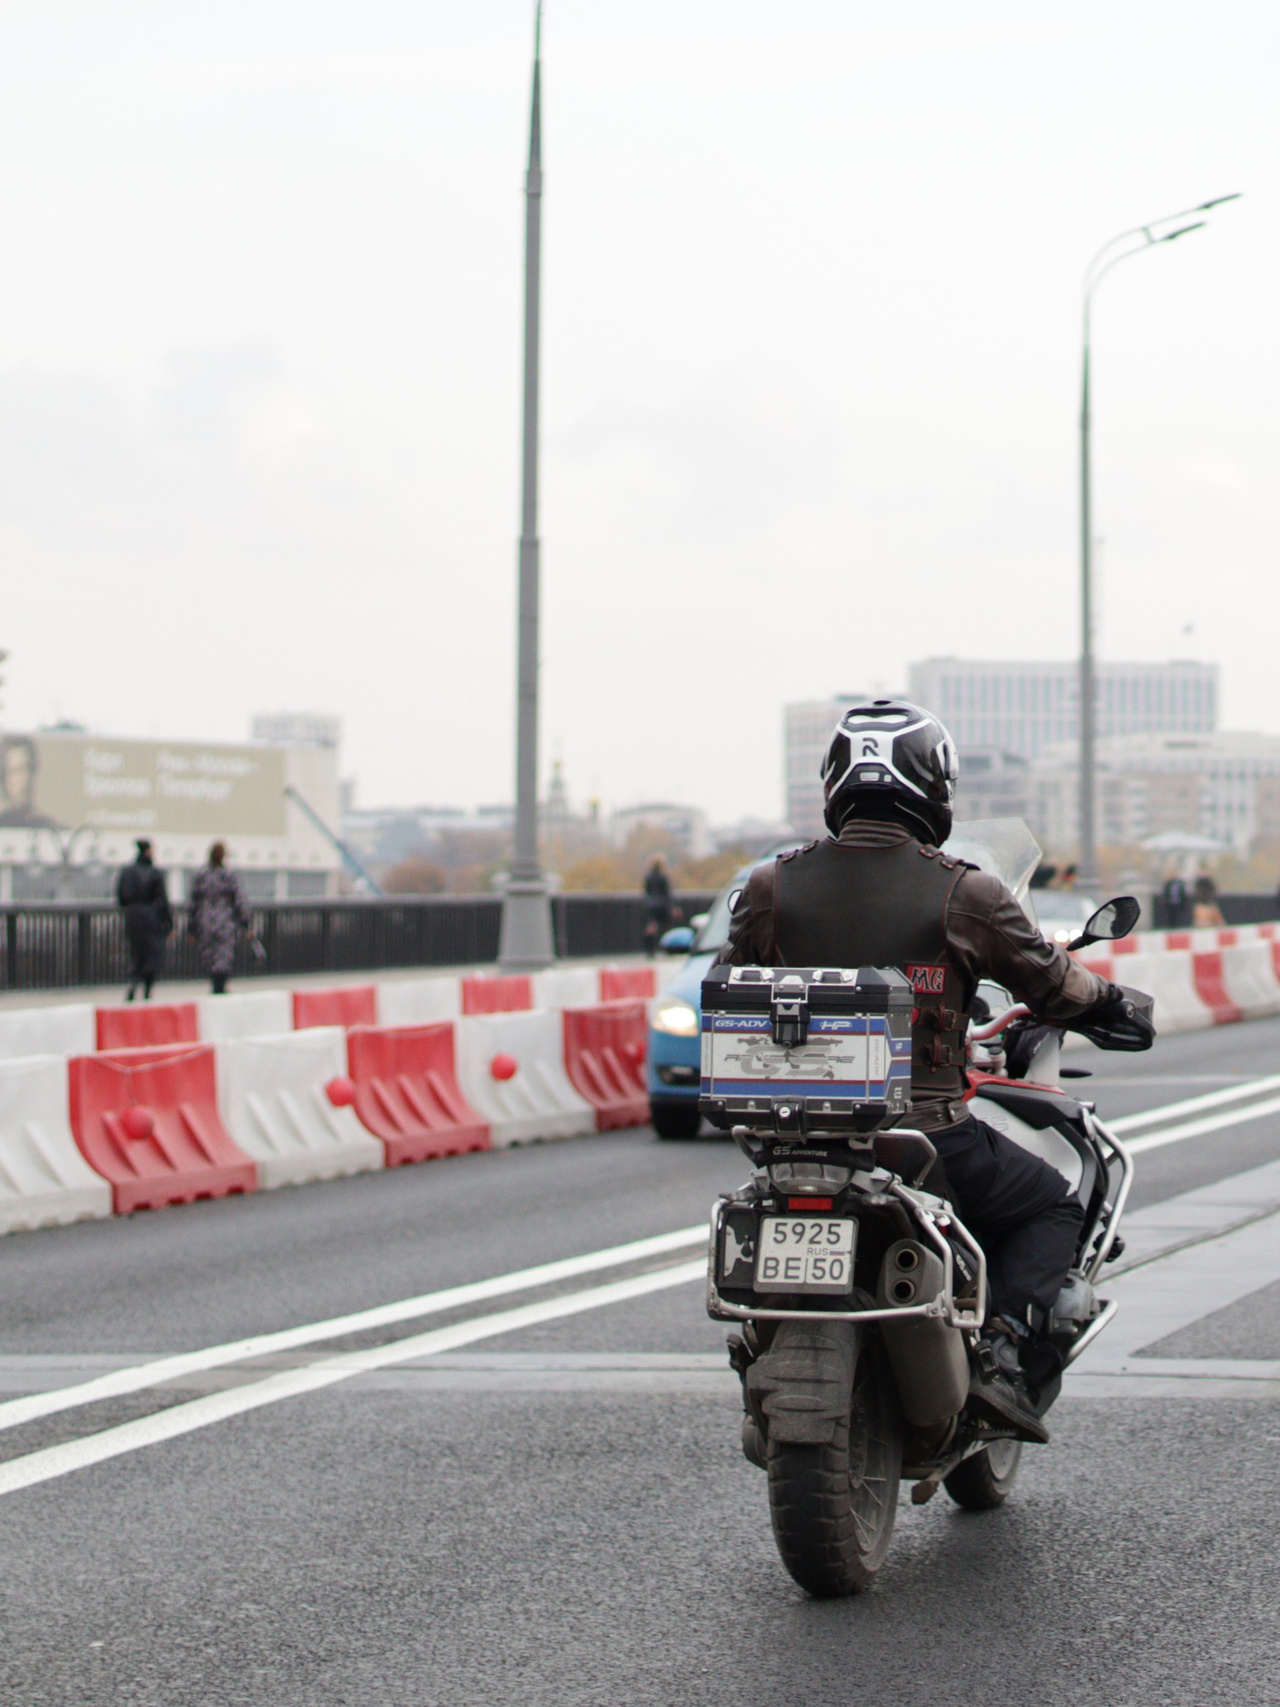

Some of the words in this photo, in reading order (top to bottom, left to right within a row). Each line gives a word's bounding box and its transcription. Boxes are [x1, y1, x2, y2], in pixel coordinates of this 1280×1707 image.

[715, 1020, 768, 1028] GS-ADV
[820, 1021, 852, 1031] HP
[772, 1146, 791, 1156] GS
[773, 1222, 841, 1245] 5925
[807, 1248, 829, 1256] RUS
[762, 1256, 801, 1279] BE
[811, 1258, 844, 1280] 50
